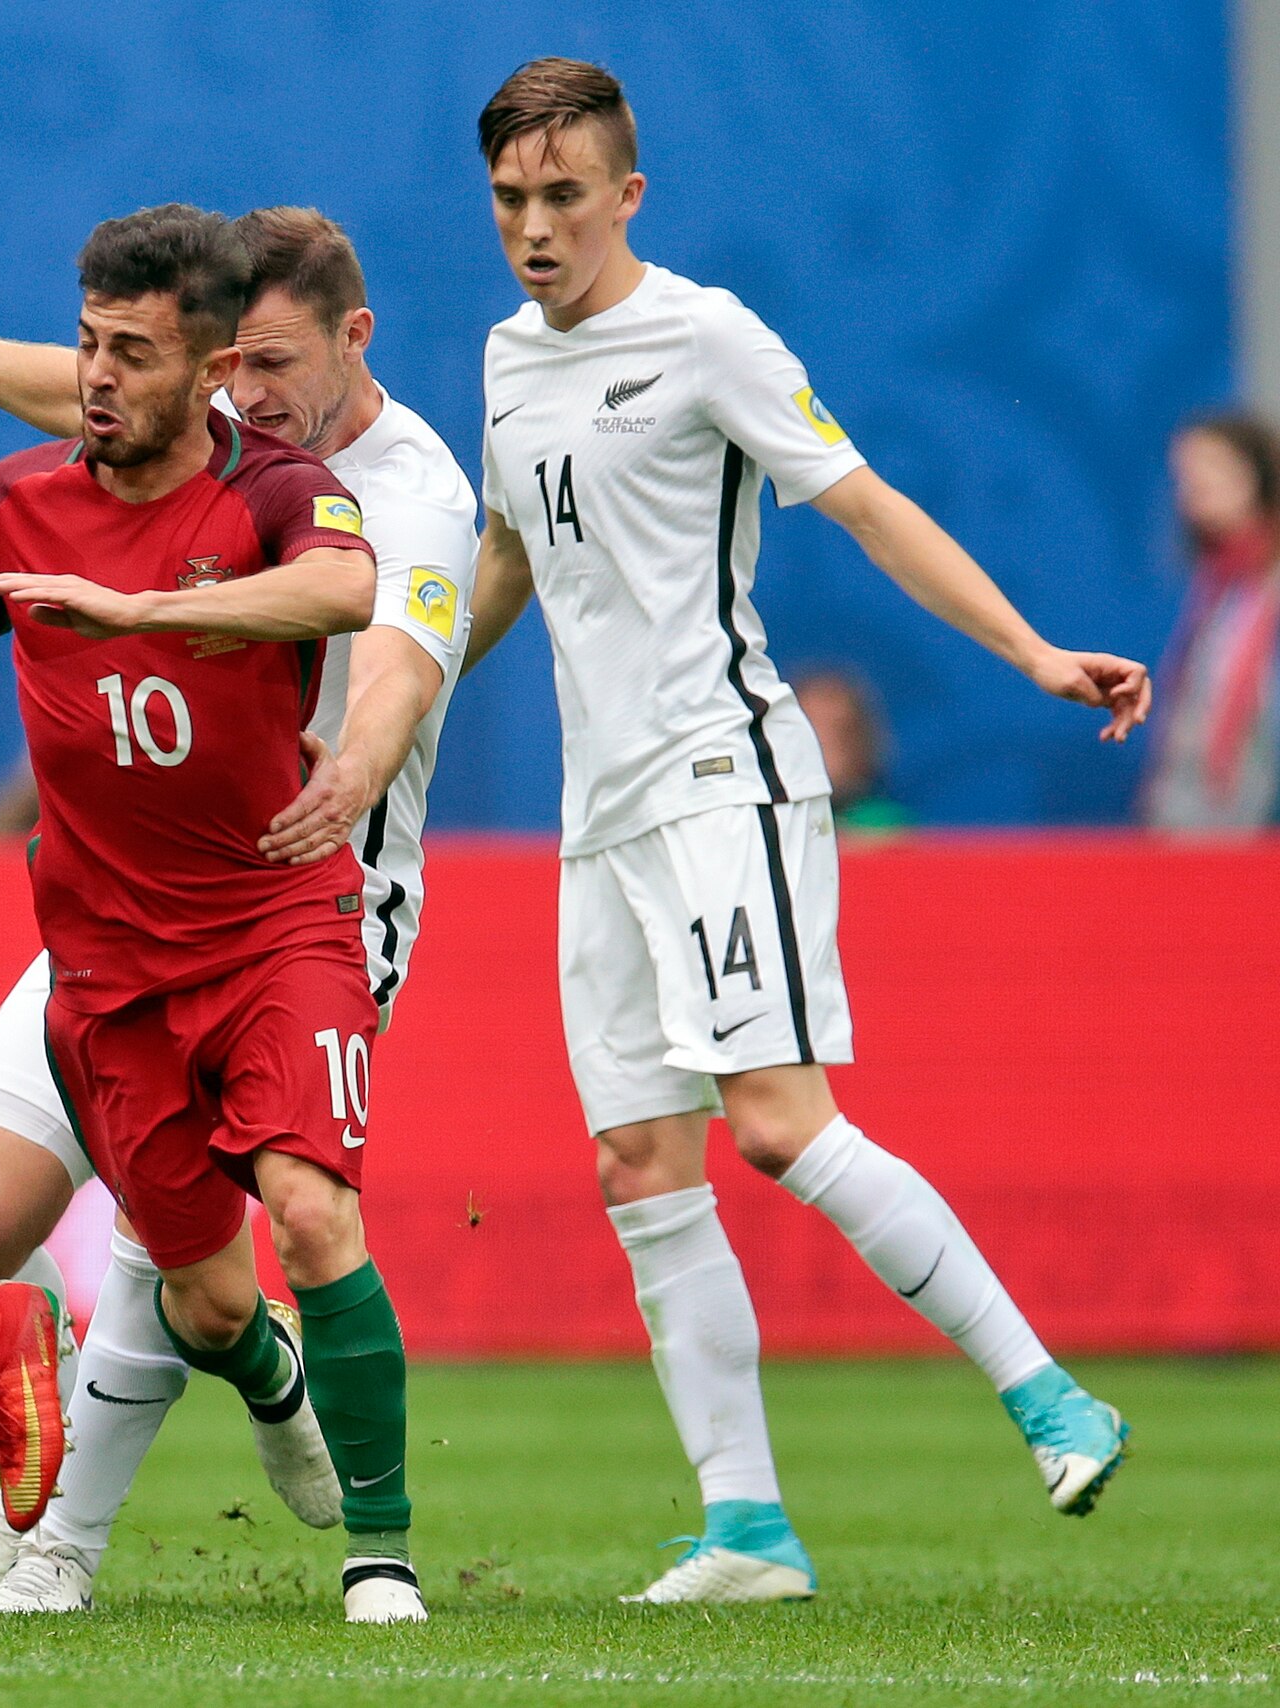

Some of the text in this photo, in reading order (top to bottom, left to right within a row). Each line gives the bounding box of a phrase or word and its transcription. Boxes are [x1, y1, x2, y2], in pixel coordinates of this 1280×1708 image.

[592, 416, 656, 426] NEW ZEALAND
[596, 425, 647, 434] FOOTBALL
[535, 454, 584, 547] 14
[96, 672, 193, 767] 10
[690, 905, 762, 1001] 14
[314, 1027, 372, 1128] 10
